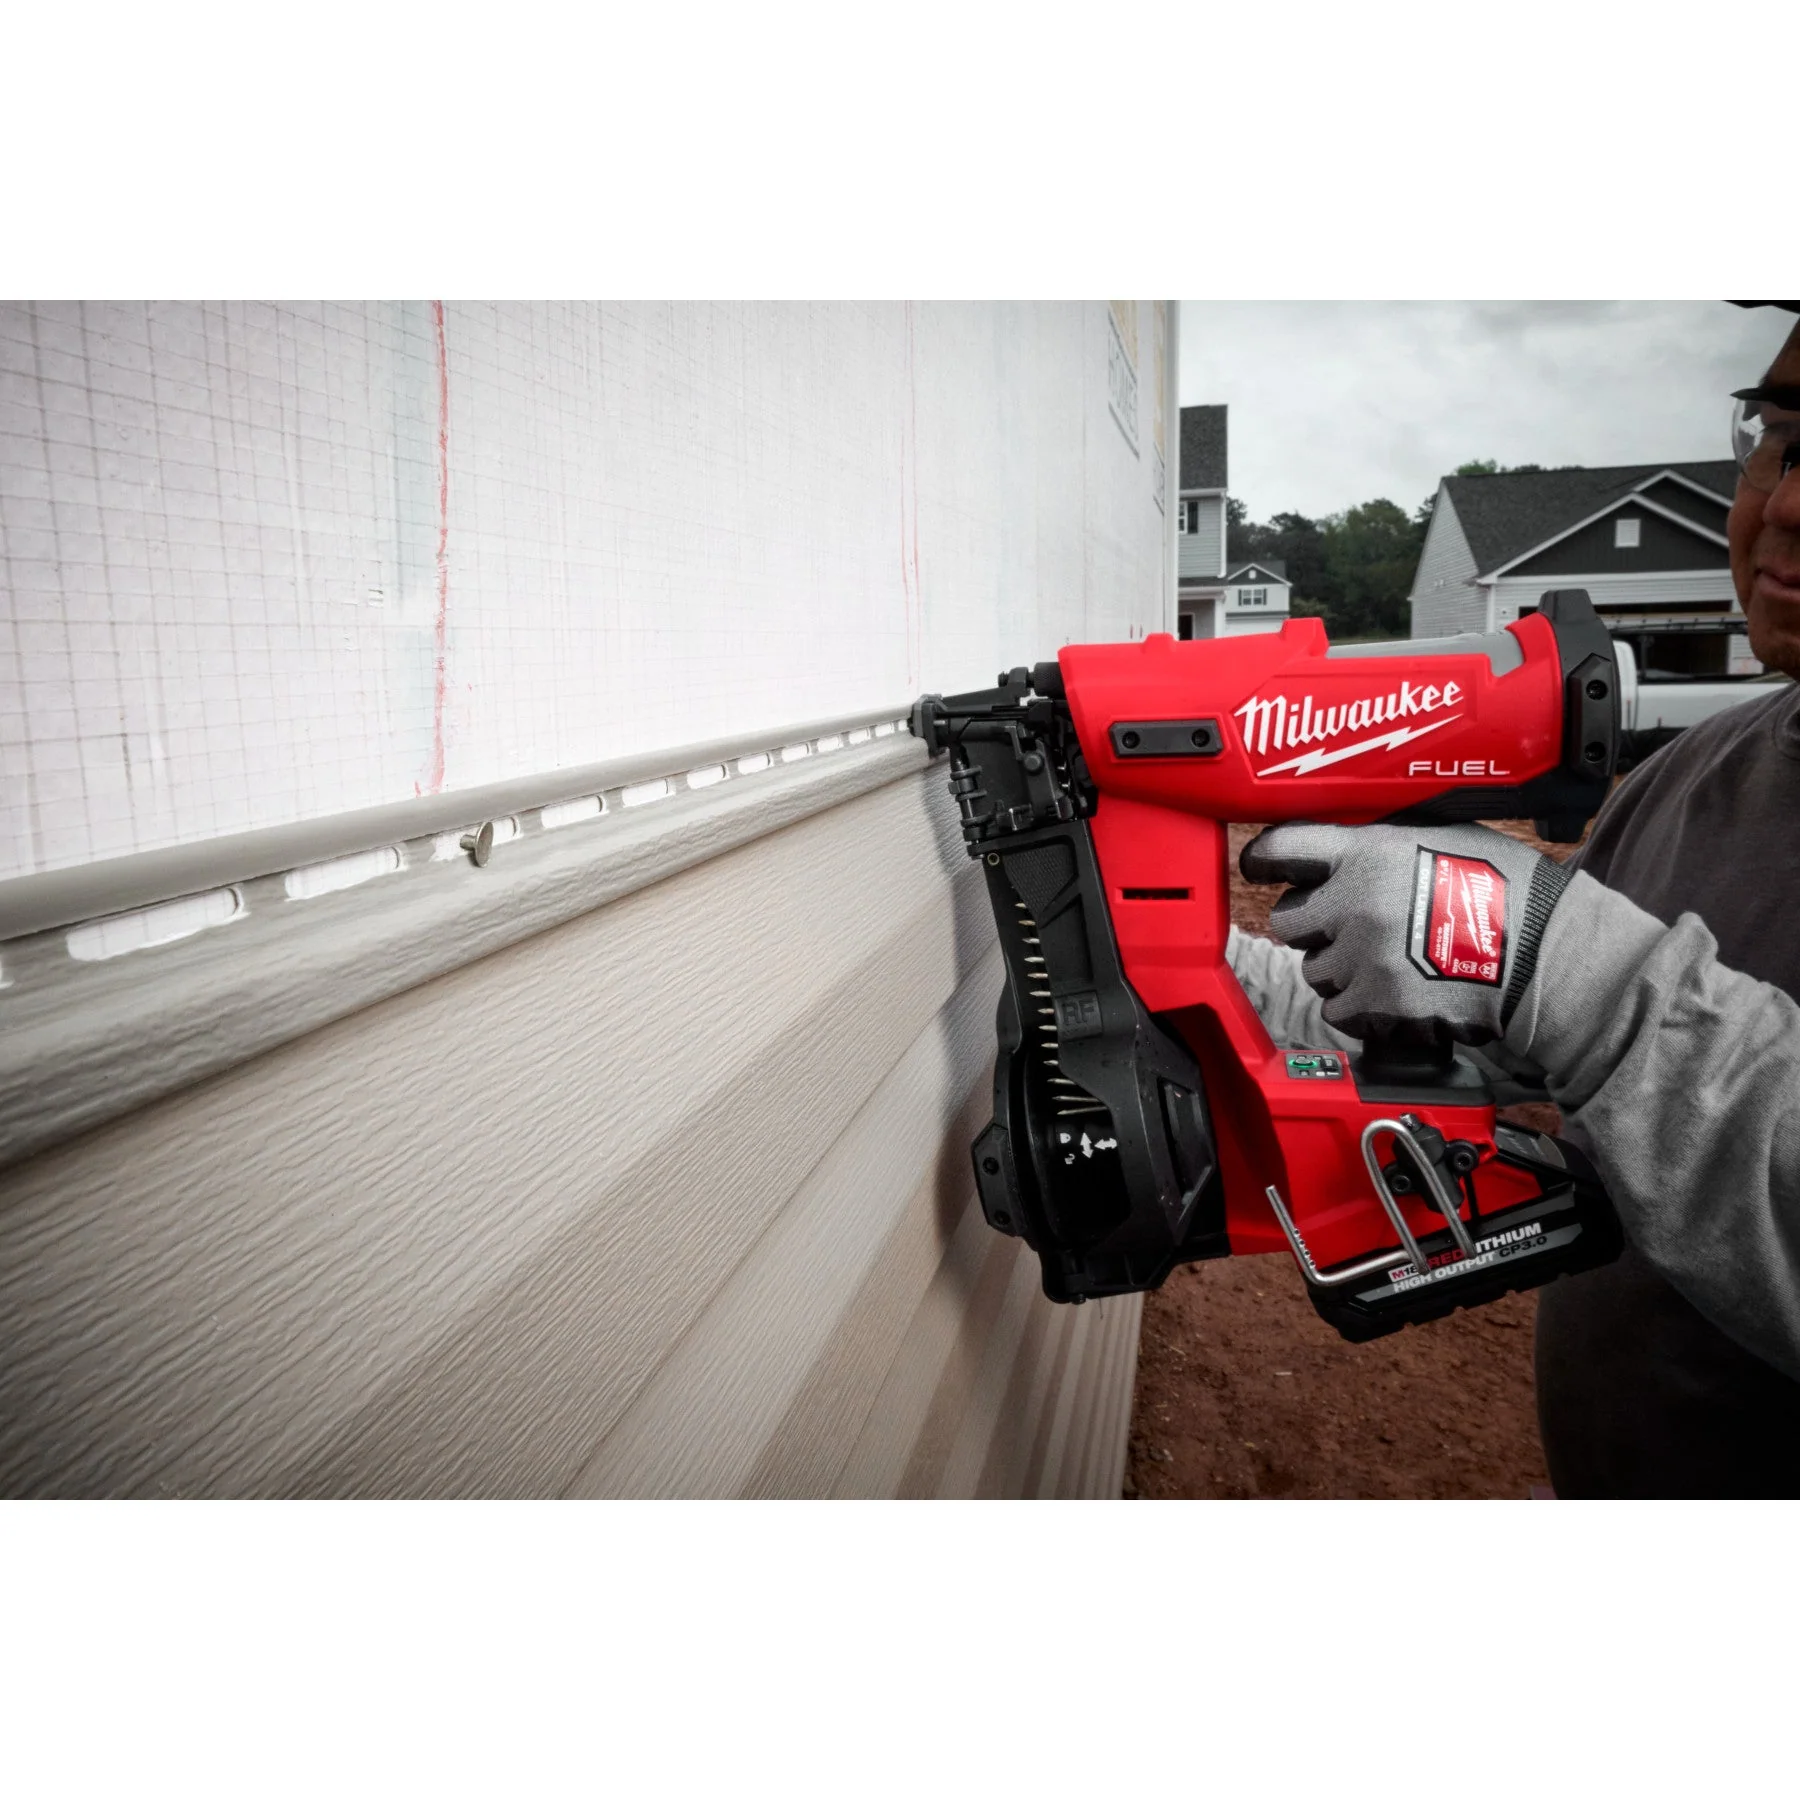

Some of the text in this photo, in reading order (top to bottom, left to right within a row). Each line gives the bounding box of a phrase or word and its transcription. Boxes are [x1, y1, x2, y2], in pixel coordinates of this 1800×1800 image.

[1234, 681, 1464, 756] Milwaukee
[1408, 760, 1510, 776] FUEL
[1415, 894, 1429, 929] LEVEL
[1393, 1235, 1548, 1293] HIGH OUTPUT CP3.0
[1427, 1222, 1542, 1269] REDITHIUM
